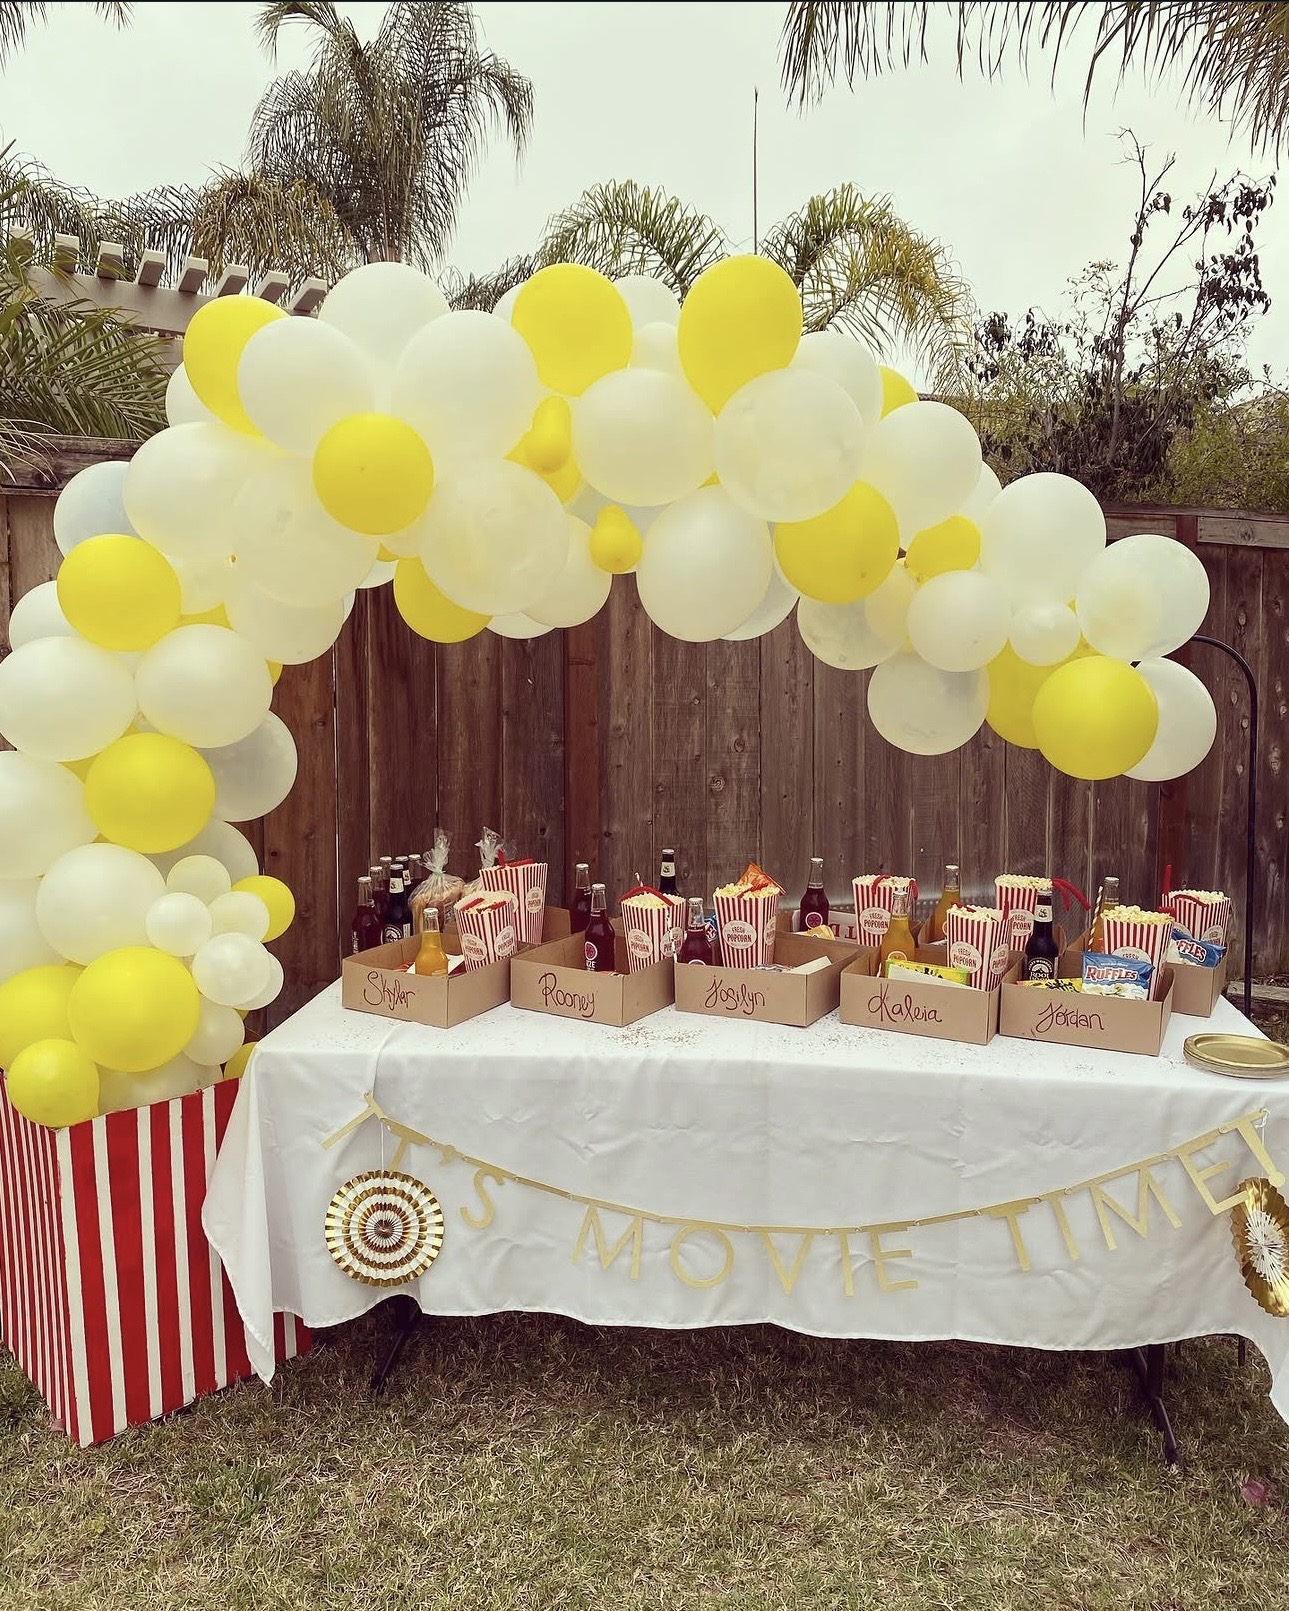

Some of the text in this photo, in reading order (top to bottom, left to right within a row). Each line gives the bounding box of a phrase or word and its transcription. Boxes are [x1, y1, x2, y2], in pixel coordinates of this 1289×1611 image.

[732, 926, 746, 934] FRESH
[864, 919, 888, 929] POPCORN
[1012, 921, 1031, 931] PCORN
[727, 933, 752, 943] POPCORN
[953, 953, 977, 968] POPCORN
[1085, 965, 1139, 982] RUFFLES
[363, 971, 416, 1011] Skylar
[538, 972, 595, 1018] Rooney
[867, 983, 943, 1023] Kaleia
[1035, 1000, 1105, 1034] Jordan
[568, 1198, 919, 1297] MOVIE
[988, 1108, 1286, 1273] TIME!
